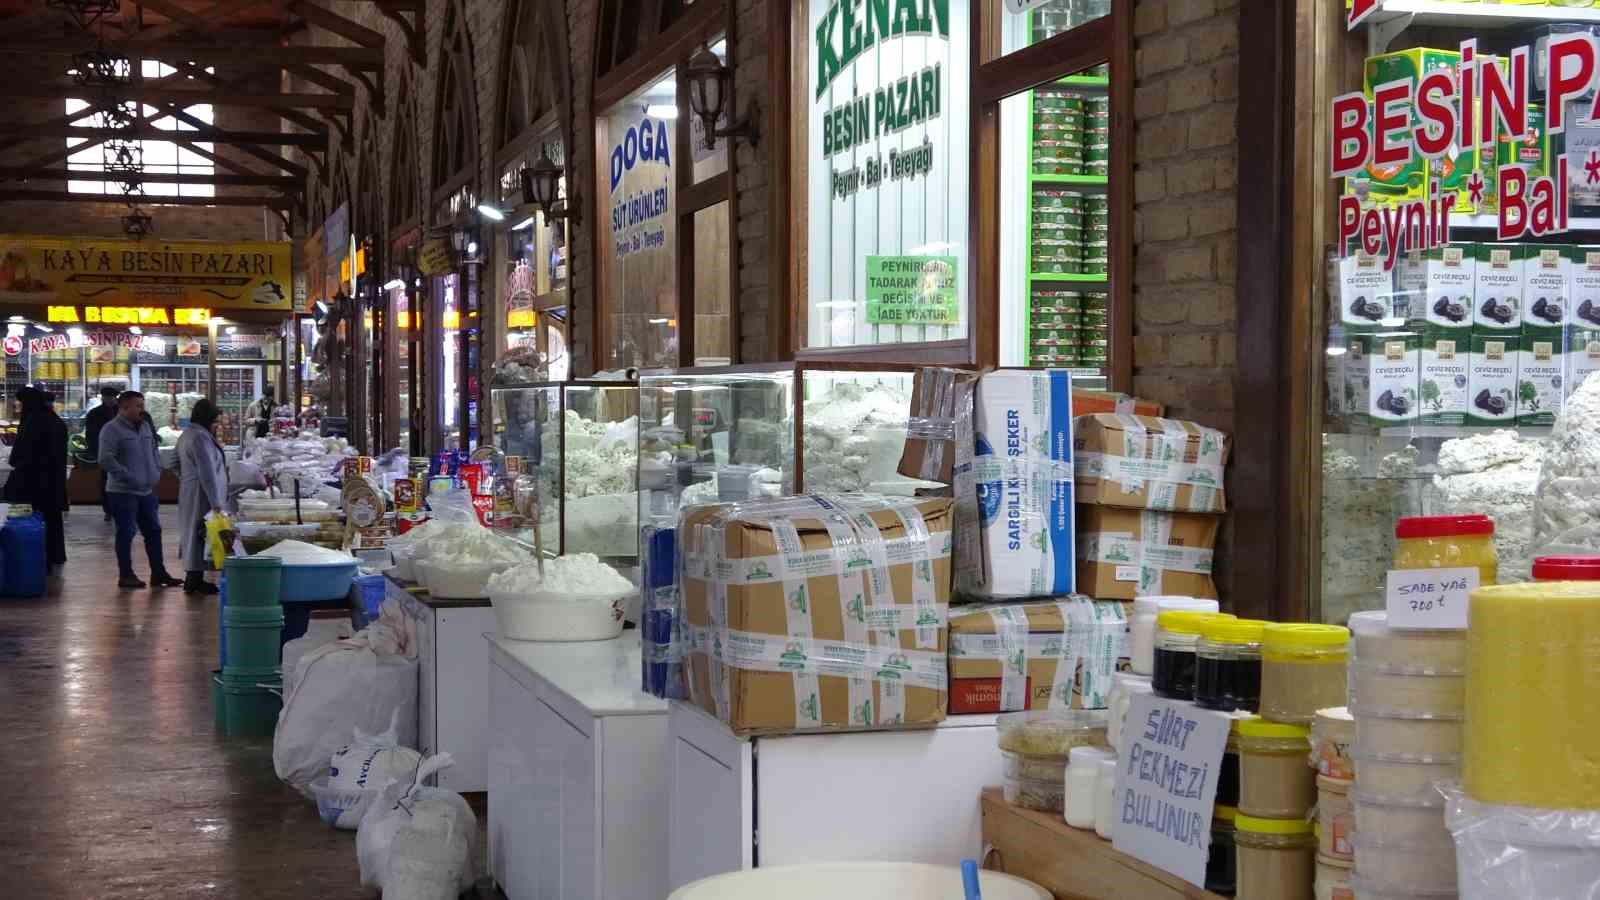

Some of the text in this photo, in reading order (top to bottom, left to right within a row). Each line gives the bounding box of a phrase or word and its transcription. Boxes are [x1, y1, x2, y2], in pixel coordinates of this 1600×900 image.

[823, 61, 942, 160] BESİN PAZARI
[1330, 31, 1600, 179] BESİN P
[610, 103, 671, 194] DOĞA
[832, 134, 934, 201] Peynir Bal Tereyağı
[613, 180, 668, 232] SÜT ÜRÜNLERİ
[1338, 153, 1569, 272] Peynir Bal
[43, 246, 274, 275] KAYA BESİN PAZARI
[31, 334, 67, 354] KAYA
[1007, 409, 1023, 457] ŞEKER
[1007, 491, 1021, 550] SARGILI
[1398, 577, 1468, 596] SADE YAĞ
[1409, 600, 1433, 613] 700
[1127, 742, 1209, 801] PEKMEZİ
[1121, 788, 1206, 850] BULUNUR
